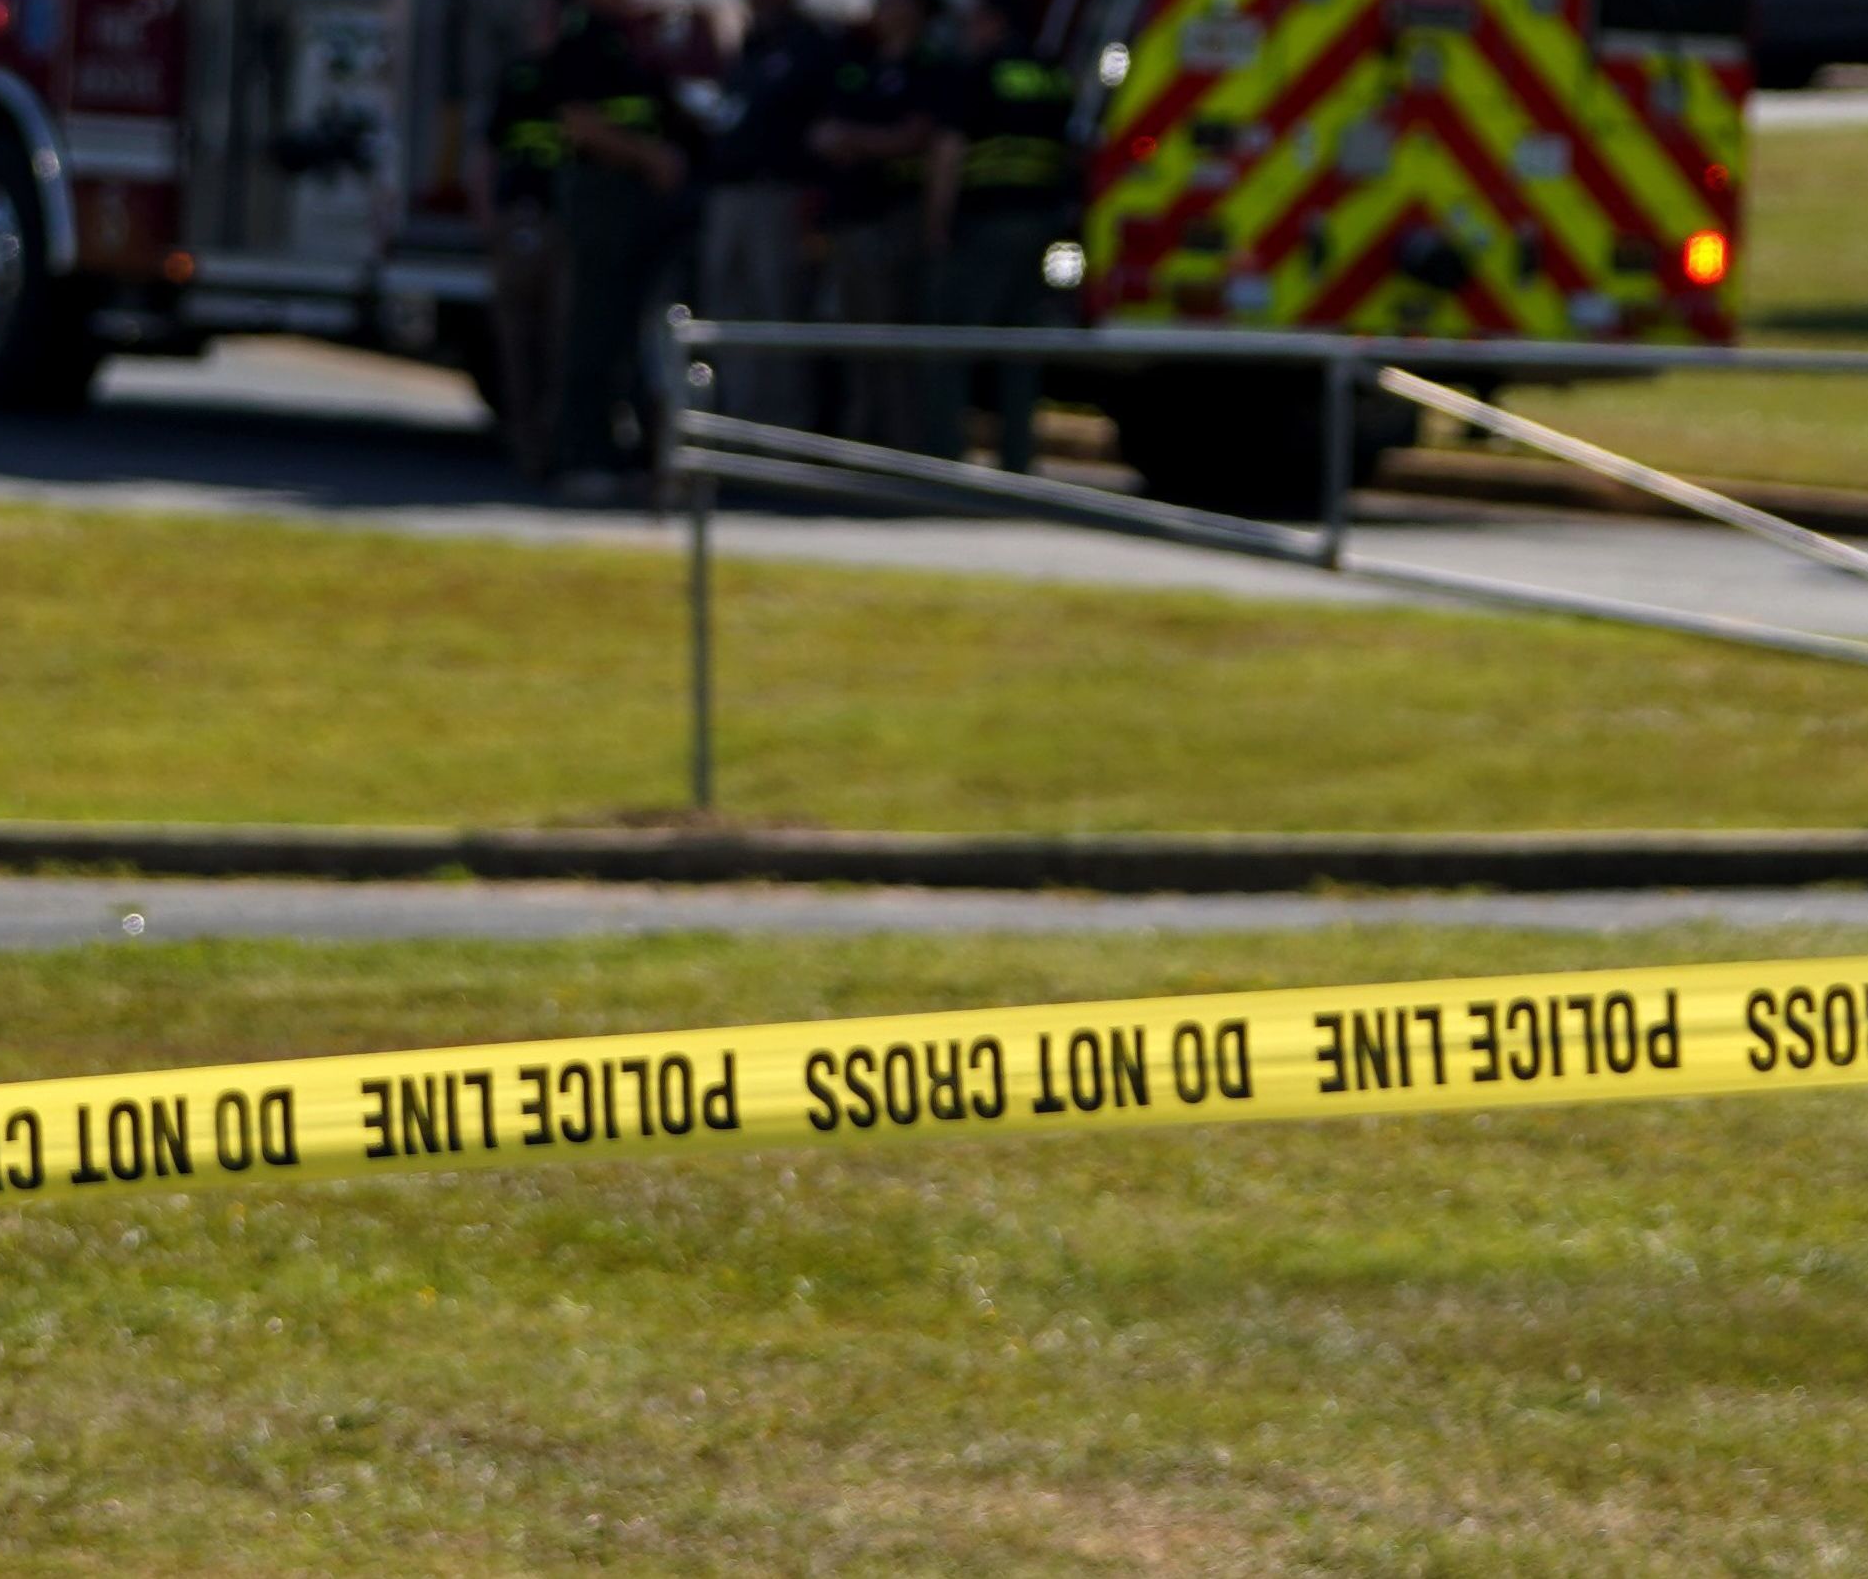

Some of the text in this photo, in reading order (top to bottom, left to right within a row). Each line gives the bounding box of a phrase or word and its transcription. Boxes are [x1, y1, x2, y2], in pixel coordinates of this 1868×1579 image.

[805, 1021, 1253, 1132] DO NOT CROSS
[1314, 991, 1680, 1093] POLICE LINE
[70, 1098, 194, 1185] NOT
[215, 1088, 300, 1172] DO
[361, 1052, 740, 1160] POLICE LINE
